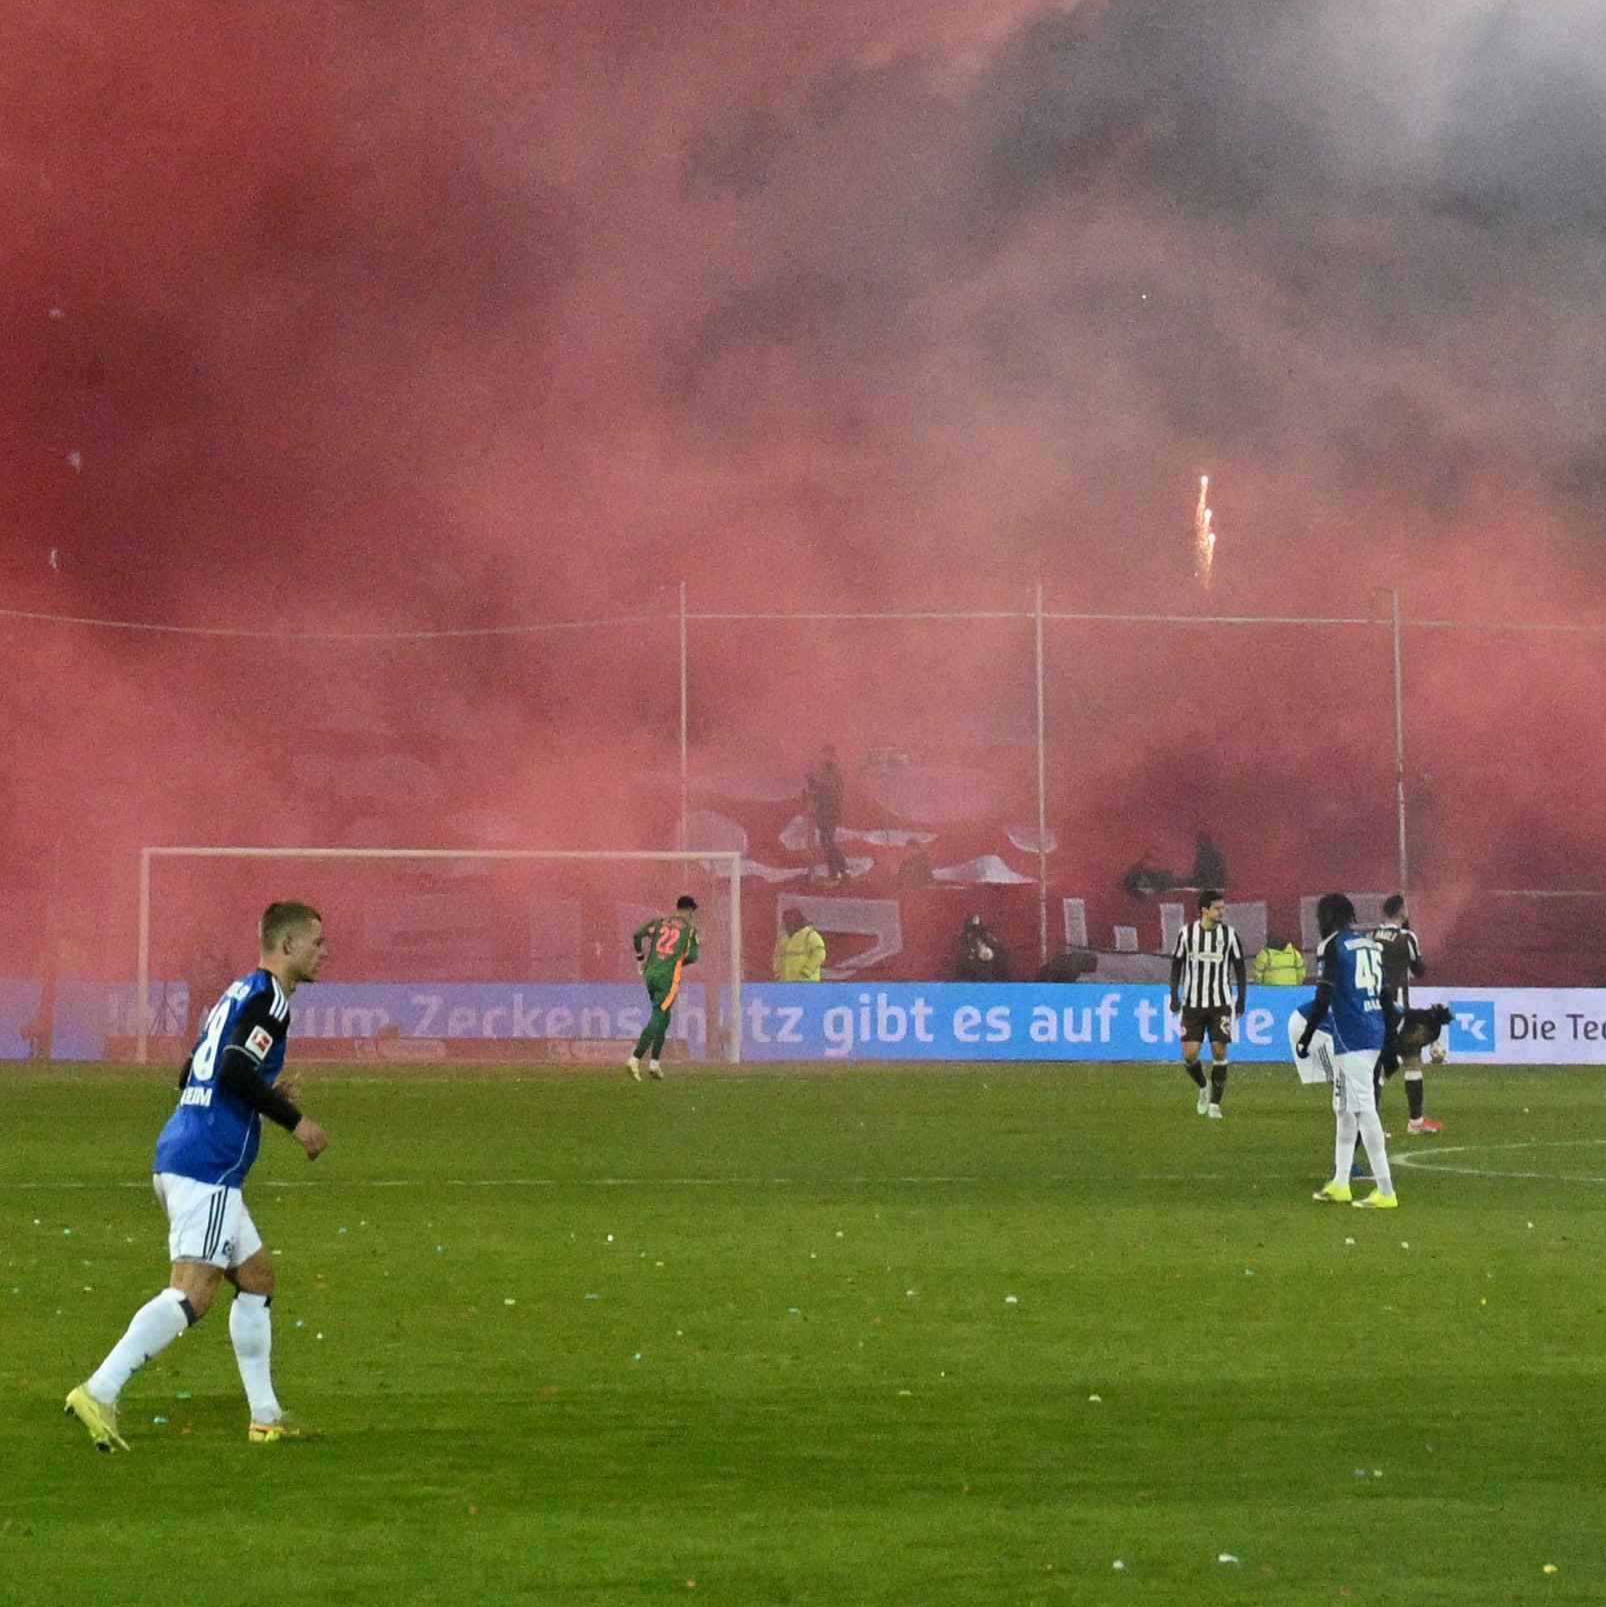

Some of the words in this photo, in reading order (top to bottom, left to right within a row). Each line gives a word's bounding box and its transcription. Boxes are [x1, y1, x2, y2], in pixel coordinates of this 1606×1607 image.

[656, 926, 680, 955] 22
[823, 994, 933, 1056] gibt
[953, 1006, 1012, 1043] es
[1029, 994, 1120, 1043] auf
[1510, 1013, 1557, 1040] Die
